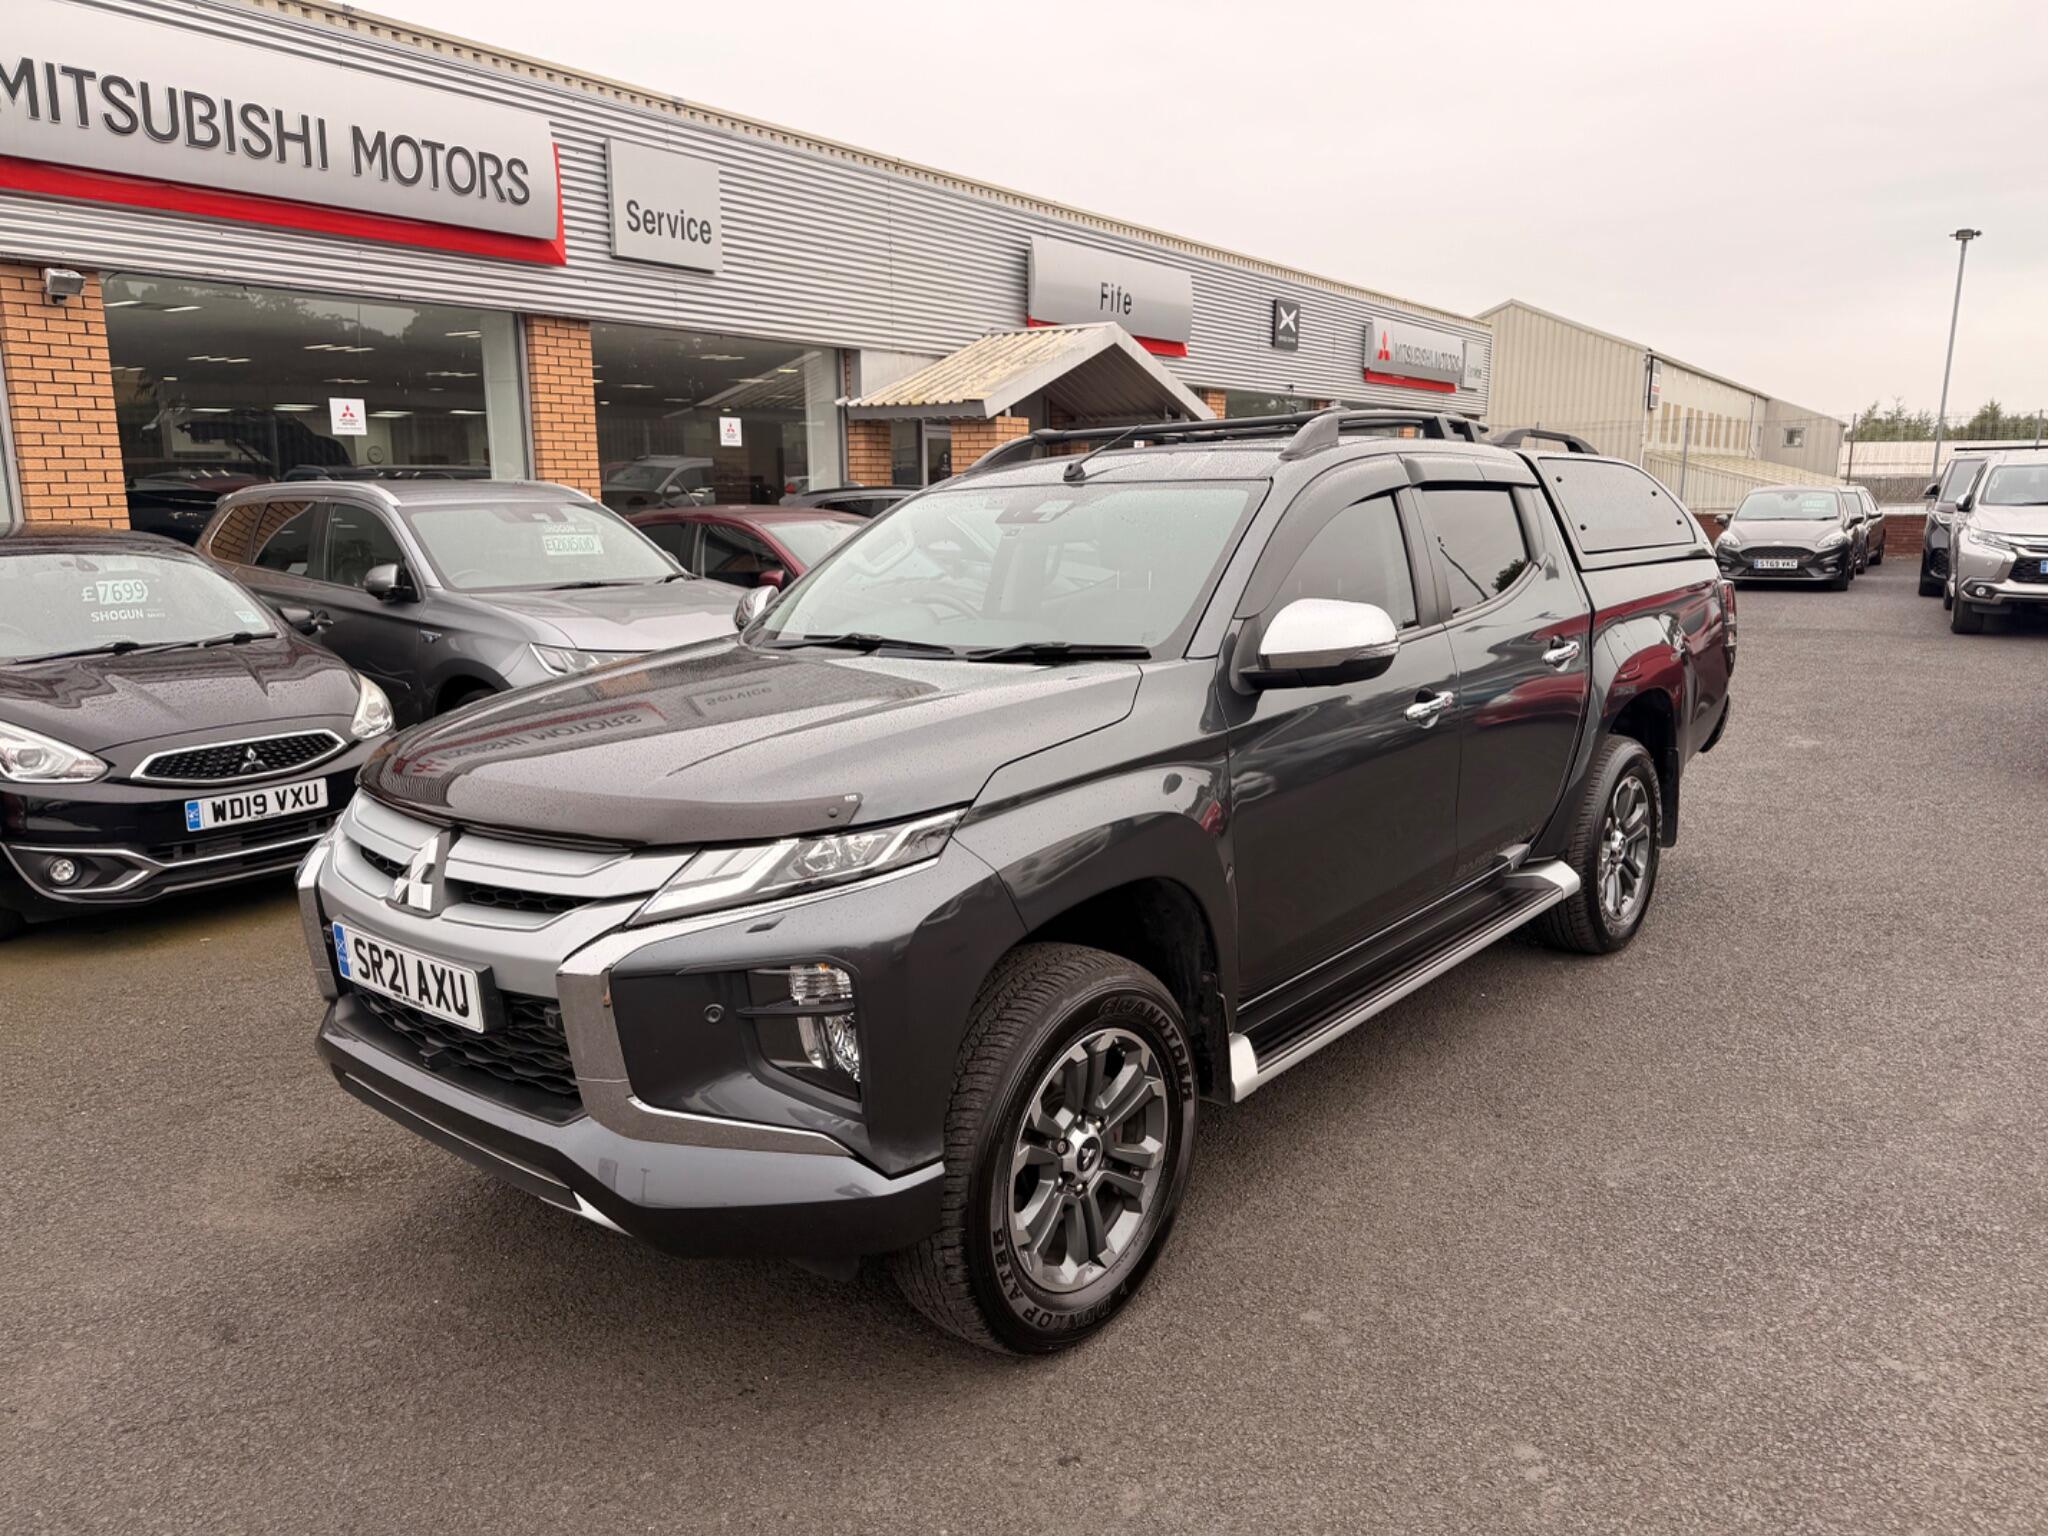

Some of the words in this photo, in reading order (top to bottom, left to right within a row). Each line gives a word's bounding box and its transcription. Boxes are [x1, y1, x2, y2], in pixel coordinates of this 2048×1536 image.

[0, 57, 328, 171] MITSUBISHI
[350, 124, 531, 205] MOTORS
[626, 199, 712, 245] Service
[1100, 281, 1132, 315] Fife
[90, 608, 145, 623] SHOGUN
[211, 793, 267, 822] WD19
[275, 783, 318, 811] VXU
[354, 937, 409, 996] SR21
[417, 959, 469, 1018] AXU
